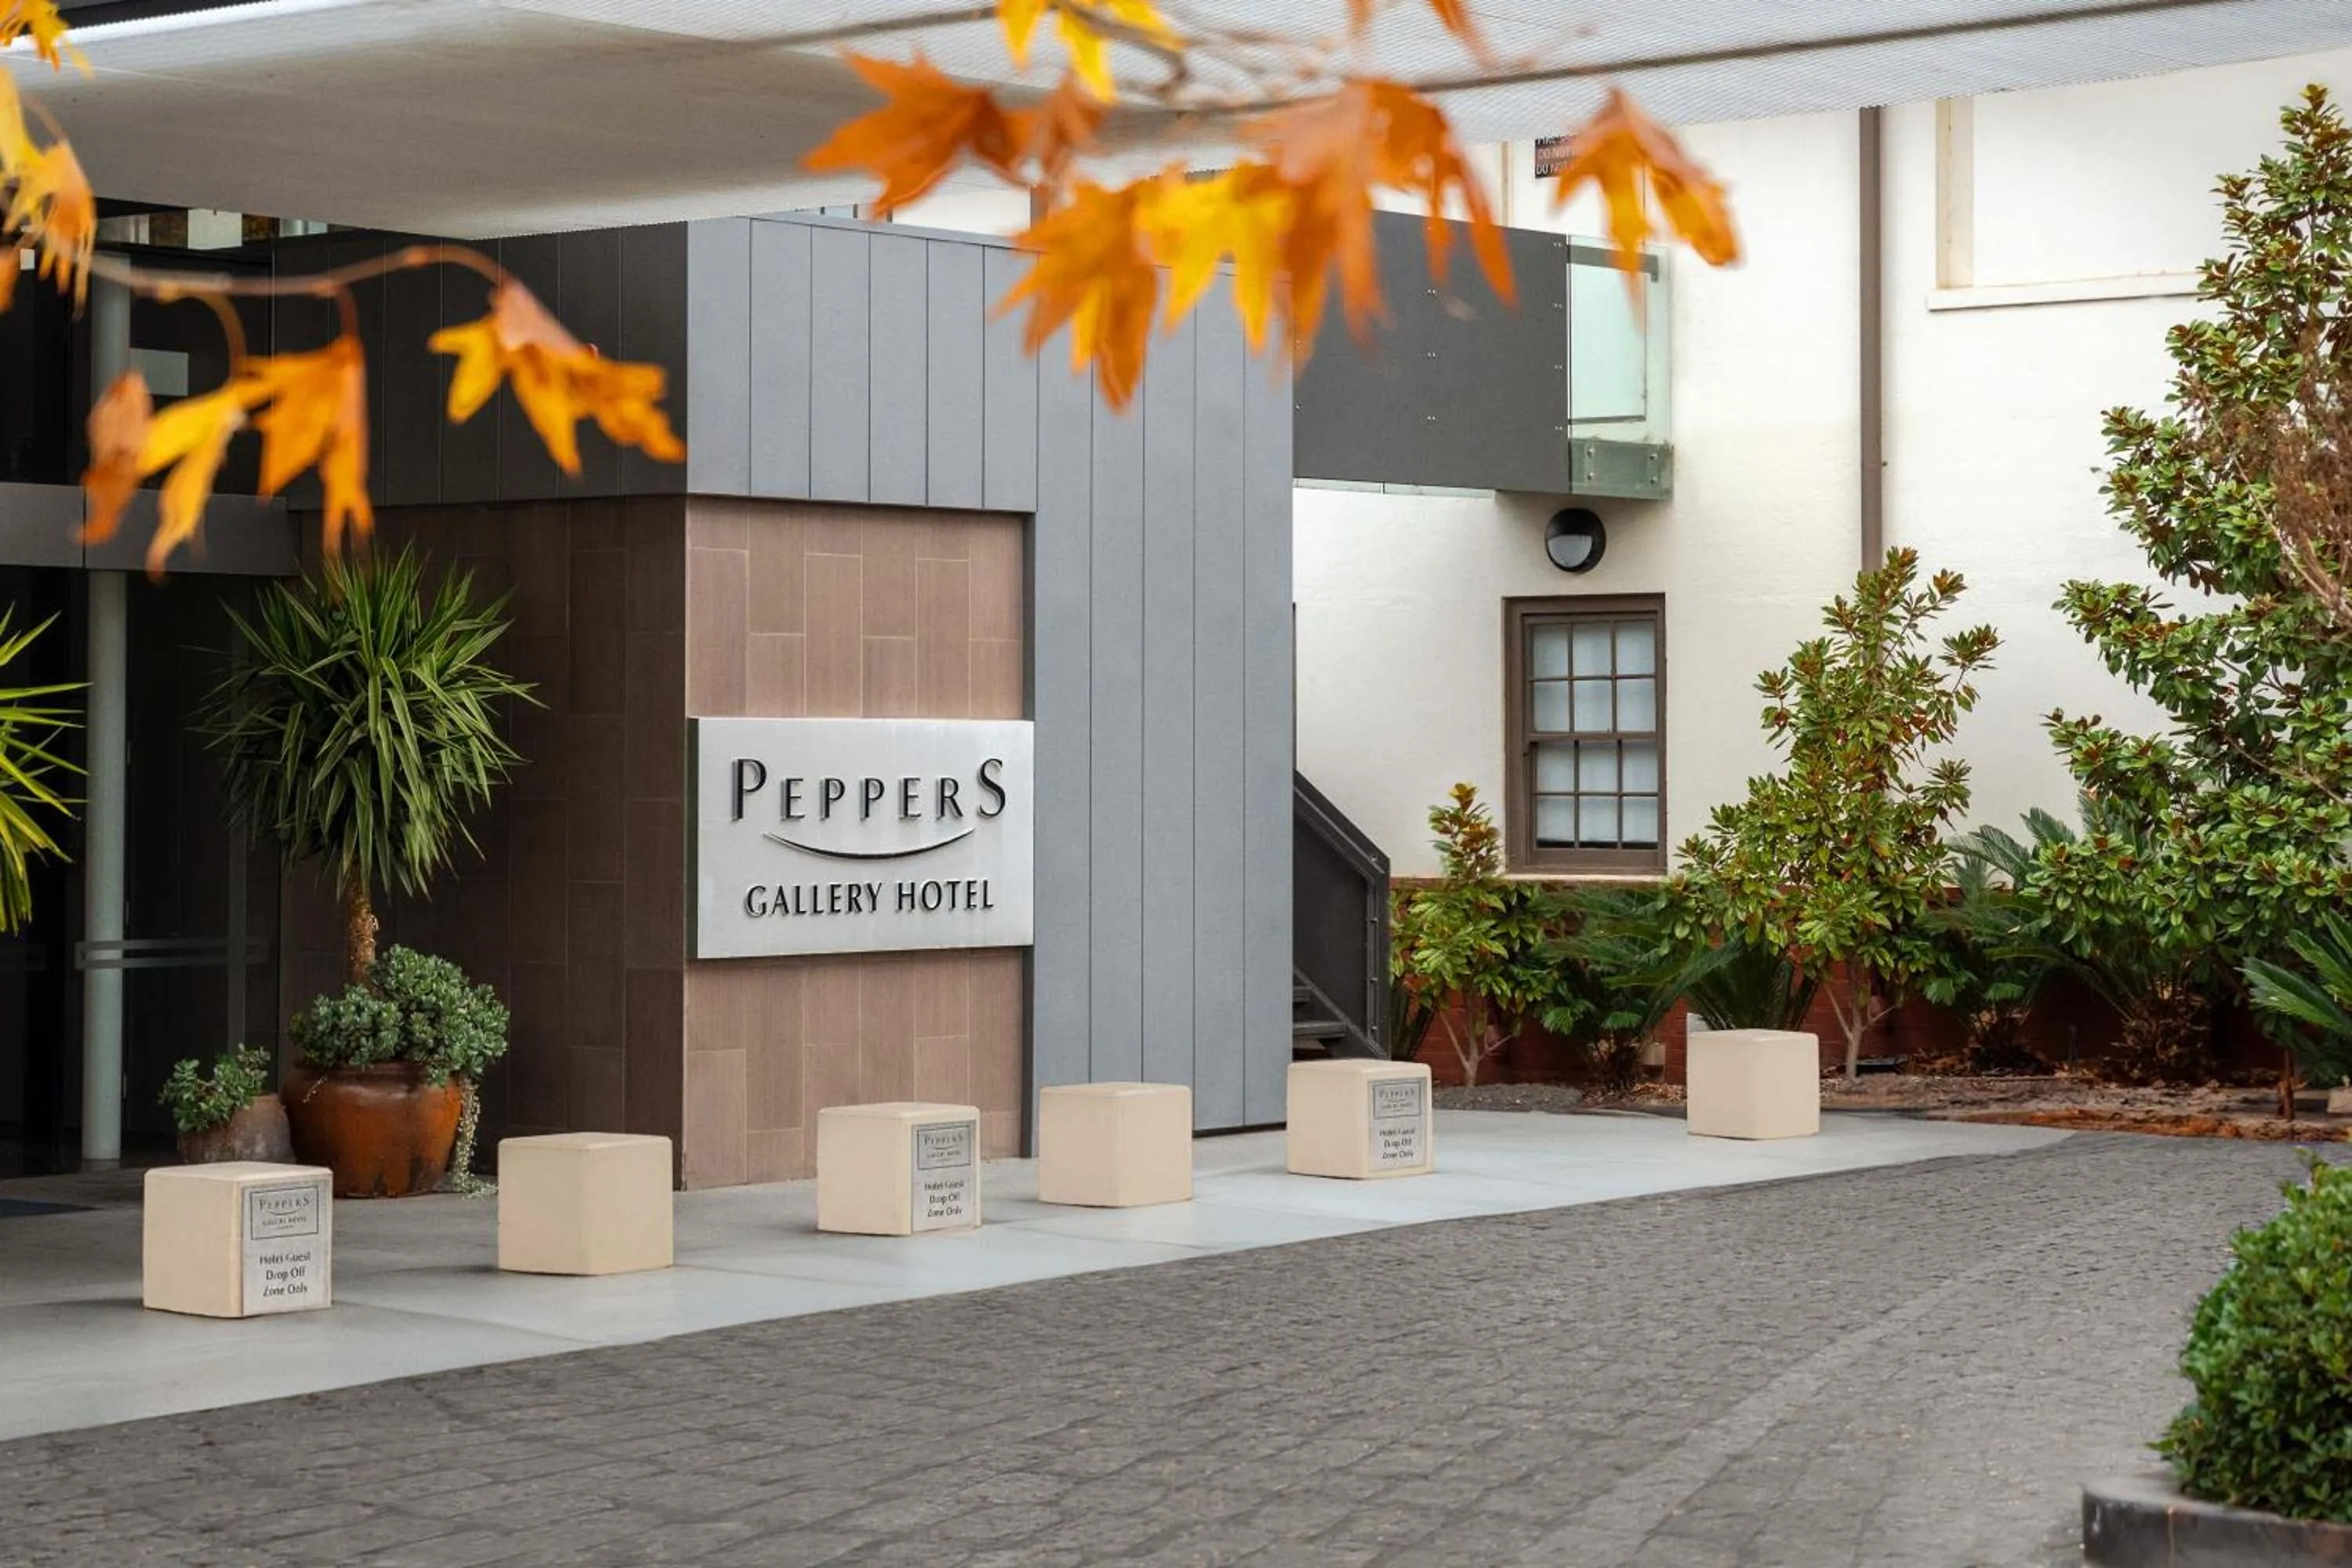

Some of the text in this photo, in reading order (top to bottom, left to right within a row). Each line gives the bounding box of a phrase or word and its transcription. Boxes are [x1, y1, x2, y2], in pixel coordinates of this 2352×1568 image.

[731, 757, 1007, 822] PEPPERS
[744, 879, 994, 917] GALLERY HOTEL
[258, 1196, 311, 1210] PEPPERS
[266, 1266, 306, 1283] Drop Off
[263, 1282, 308, 1298] Zone Only
